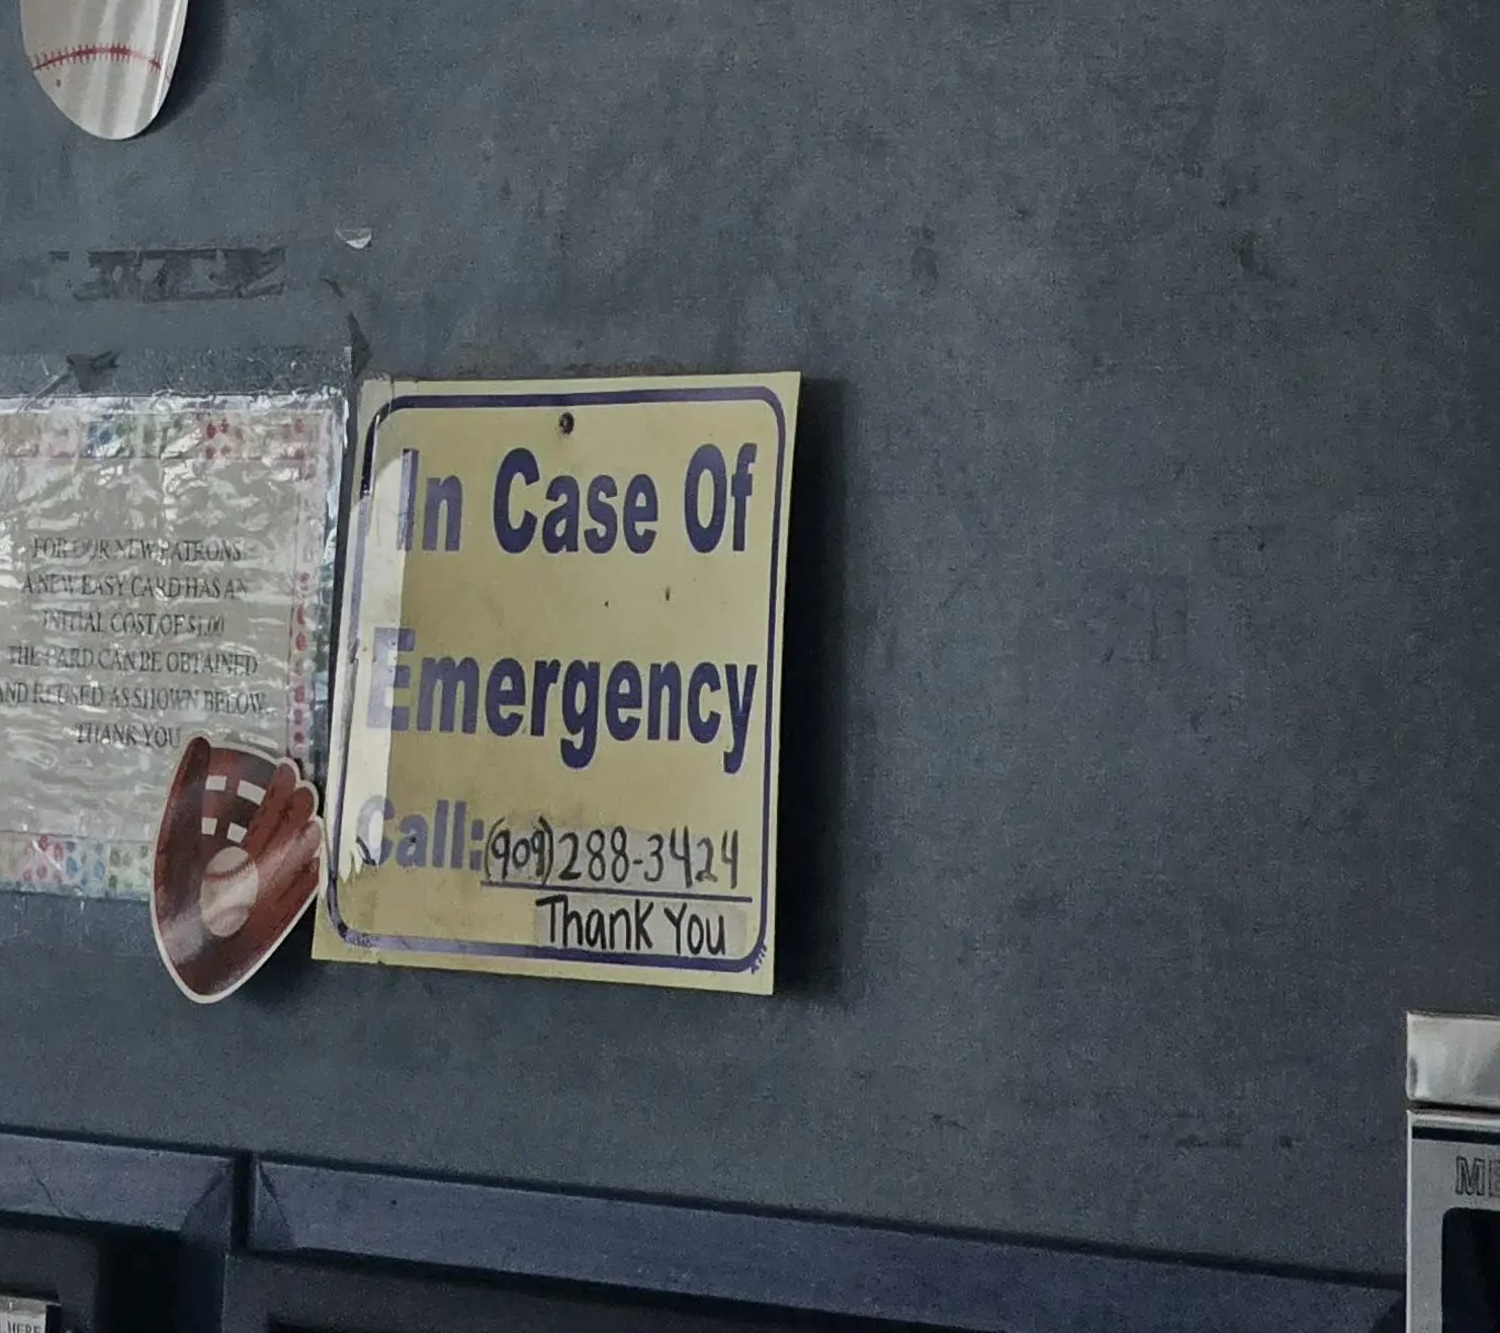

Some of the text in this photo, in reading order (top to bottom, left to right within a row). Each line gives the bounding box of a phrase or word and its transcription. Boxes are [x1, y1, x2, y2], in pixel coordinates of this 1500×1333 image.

[395, 443, 758, 554] In Case Of
[33, 536, 68, 559] FOR
[37, 574, 75, 594] NEW
[81, 574, 125, 596] EASY
[131, 575, 181, 598] CARD
[186, 576, 220, 599] HAS
[110, 612, 156, 636] COST
[160, 613, 186, 636] OF
[98, 648, 136, 672] CAN
[139, 650, 163, 673] BE
[167, 651, 258, 676] OBTAINED
[111, 686, 130, 708] AS
[132, 687, 201, 712] SHOWN
[366, 626, 758, 774] Emergency
[75, 721, 182, 750] THANK YOU
[536, 895, 726, 955] Thank You
